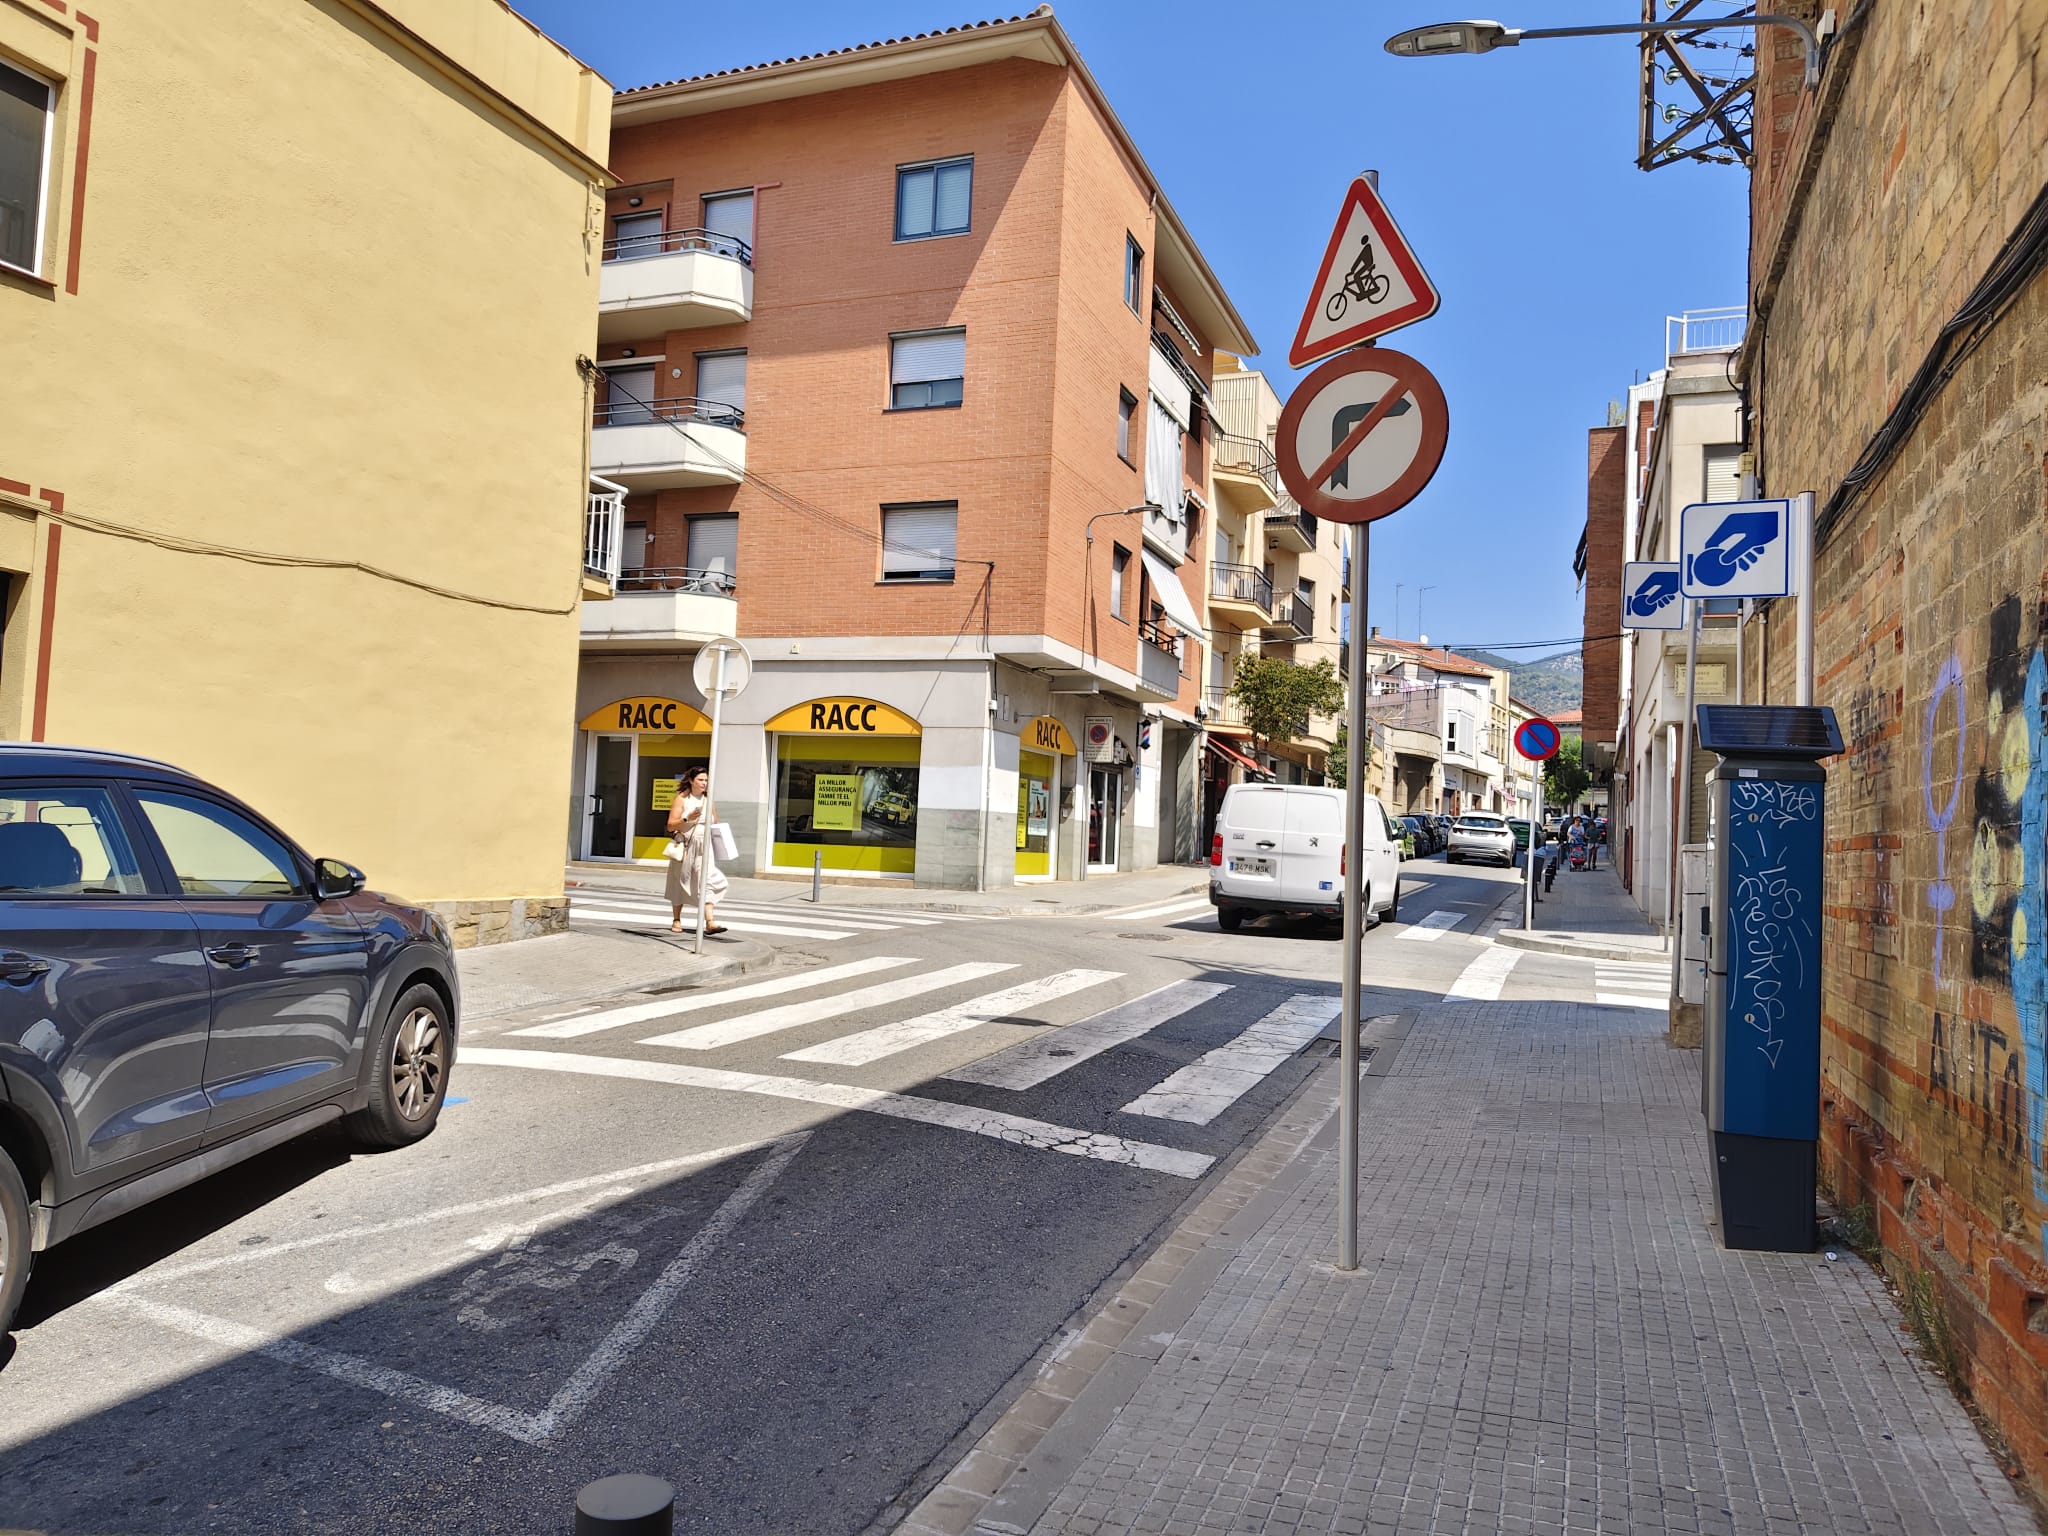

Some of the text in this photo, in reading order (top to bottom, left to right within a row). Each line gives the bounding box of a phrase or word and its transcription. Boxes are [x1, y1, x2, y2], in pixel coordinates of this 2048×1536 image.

[619, 703, 677, 729] RACC
[810, 703, 877, 731] RACC
[1036, 719, 1061, 750] RACC
